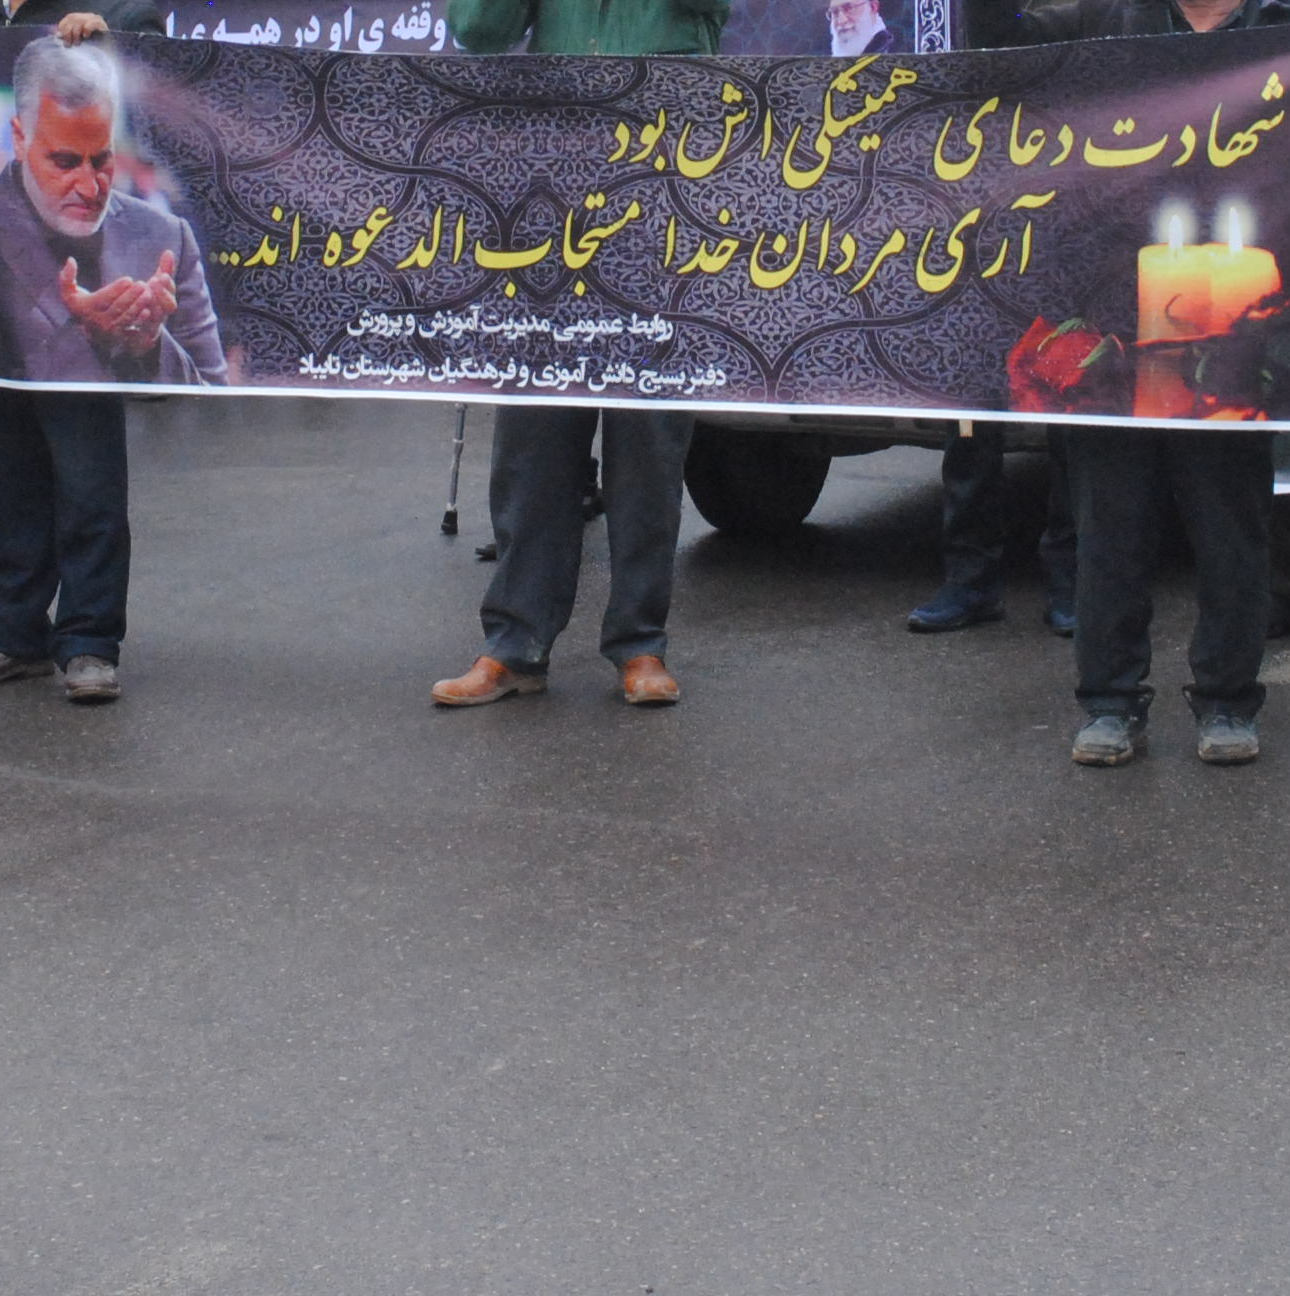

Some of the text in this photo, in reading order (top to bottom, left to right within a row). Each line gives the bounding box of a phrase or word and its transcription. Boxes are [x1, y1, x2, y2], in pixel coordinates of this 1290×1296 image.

[212, 17, 282, 44] همه
[294, 15, 320, 47] در
[328, 5, 353, 51] او
[359, 17, 384, 53] ی
[390, 0, 446, 51] وقفه
[608, 54, 1285, 190] شهادت دعای همیشگی اش بود
[472, 192, 641, 297] مستجاب
[664, 206, 742, 275] خدا
[749, 217, 906, 295] مردان
[915, 189, 1057, 294] آری
[345, 304, 674, 343] روابط عمومی مدیریت آموزش و پرورش
[298, 351, 727, 394] دفتر بسیج دانش آموزی و فرهنگیان شهرستان تایباد
